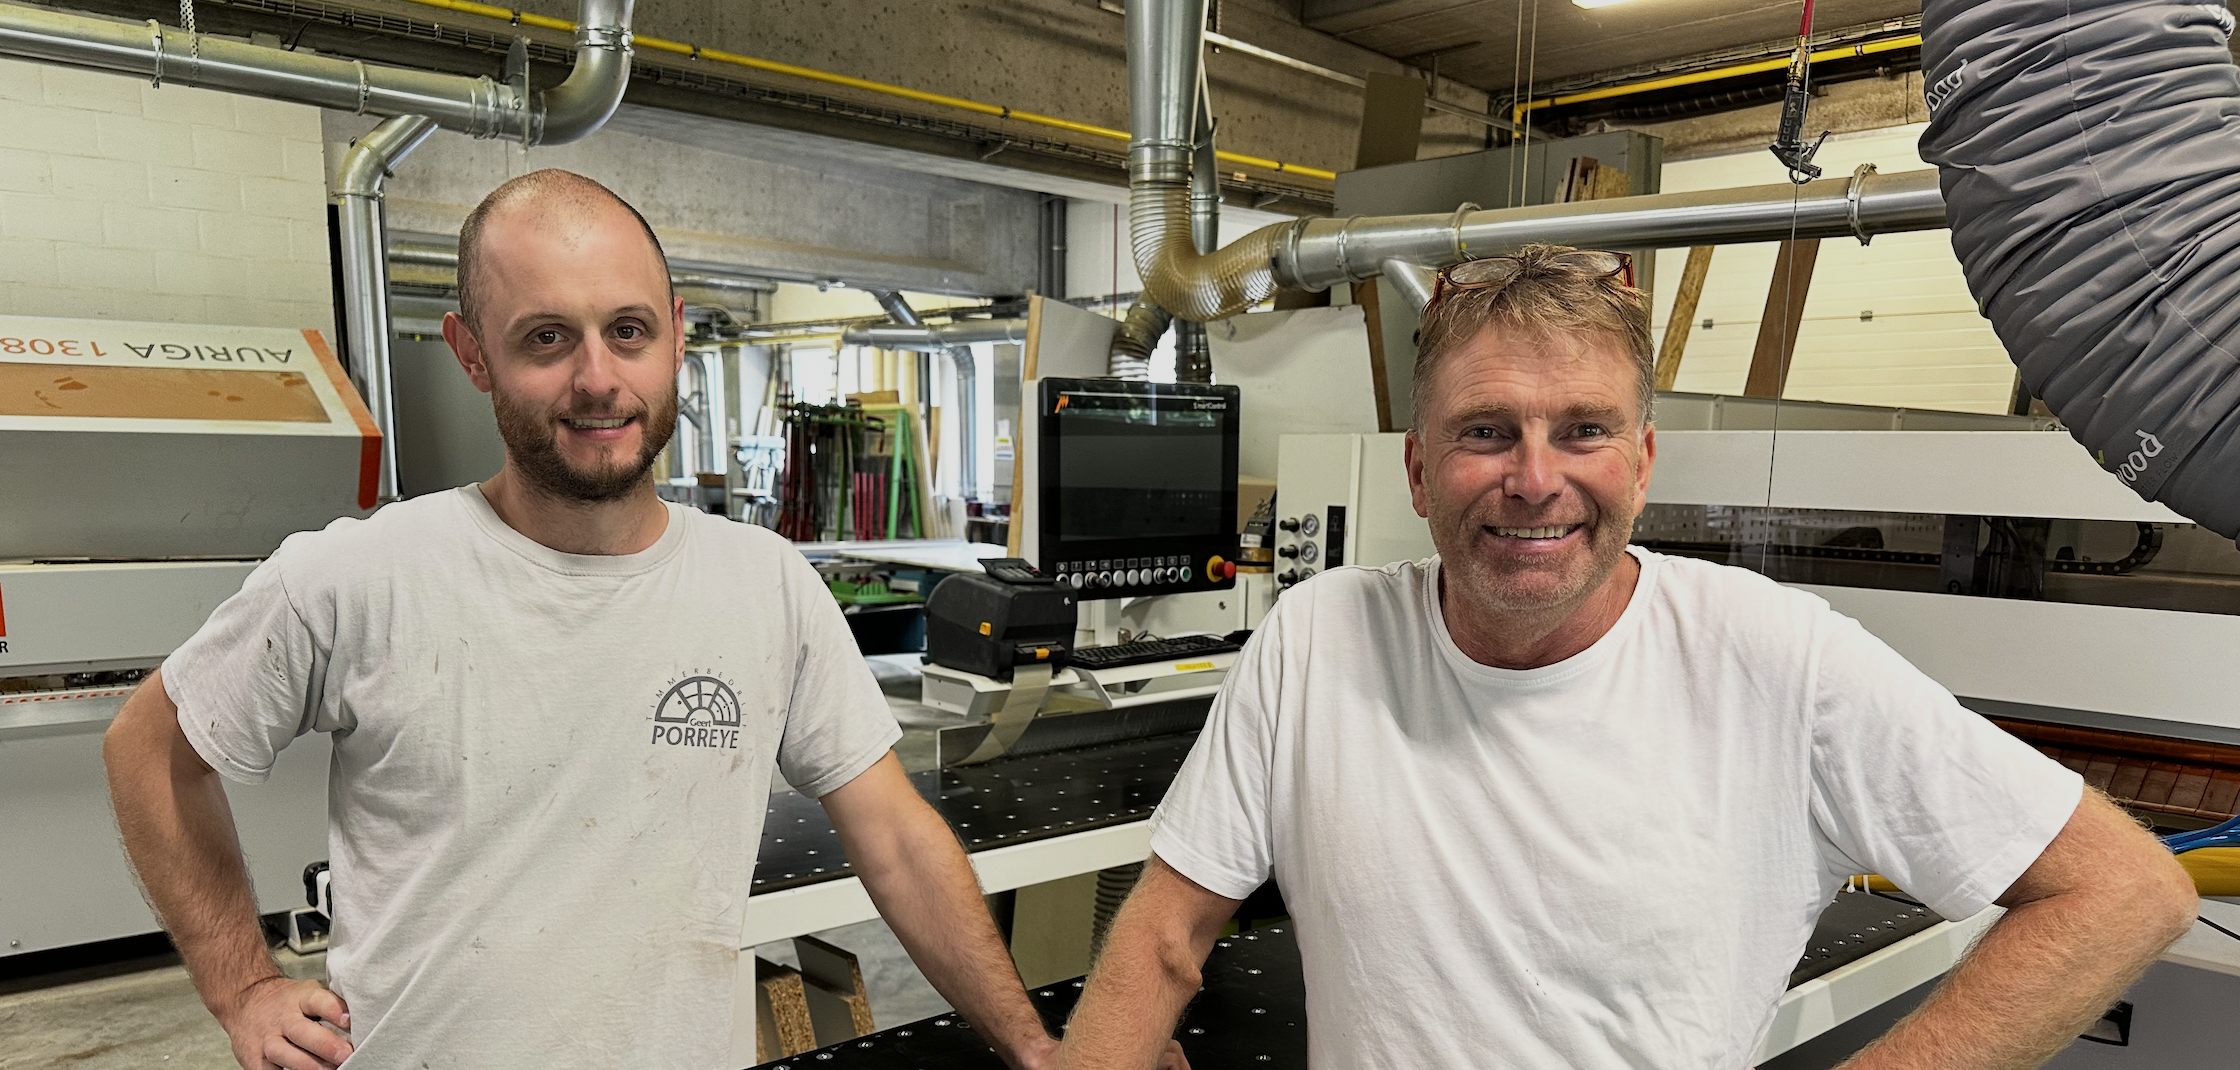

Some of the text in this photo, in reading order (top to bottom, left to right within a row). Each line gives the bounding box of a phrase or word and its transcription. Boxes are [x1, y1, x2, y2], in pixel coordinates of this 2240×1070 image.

[0, 337, 292, 363] AURIGA 1308
[689, 718, 712, 727] Geert
[651, 725, 740, 749] PORREYE
